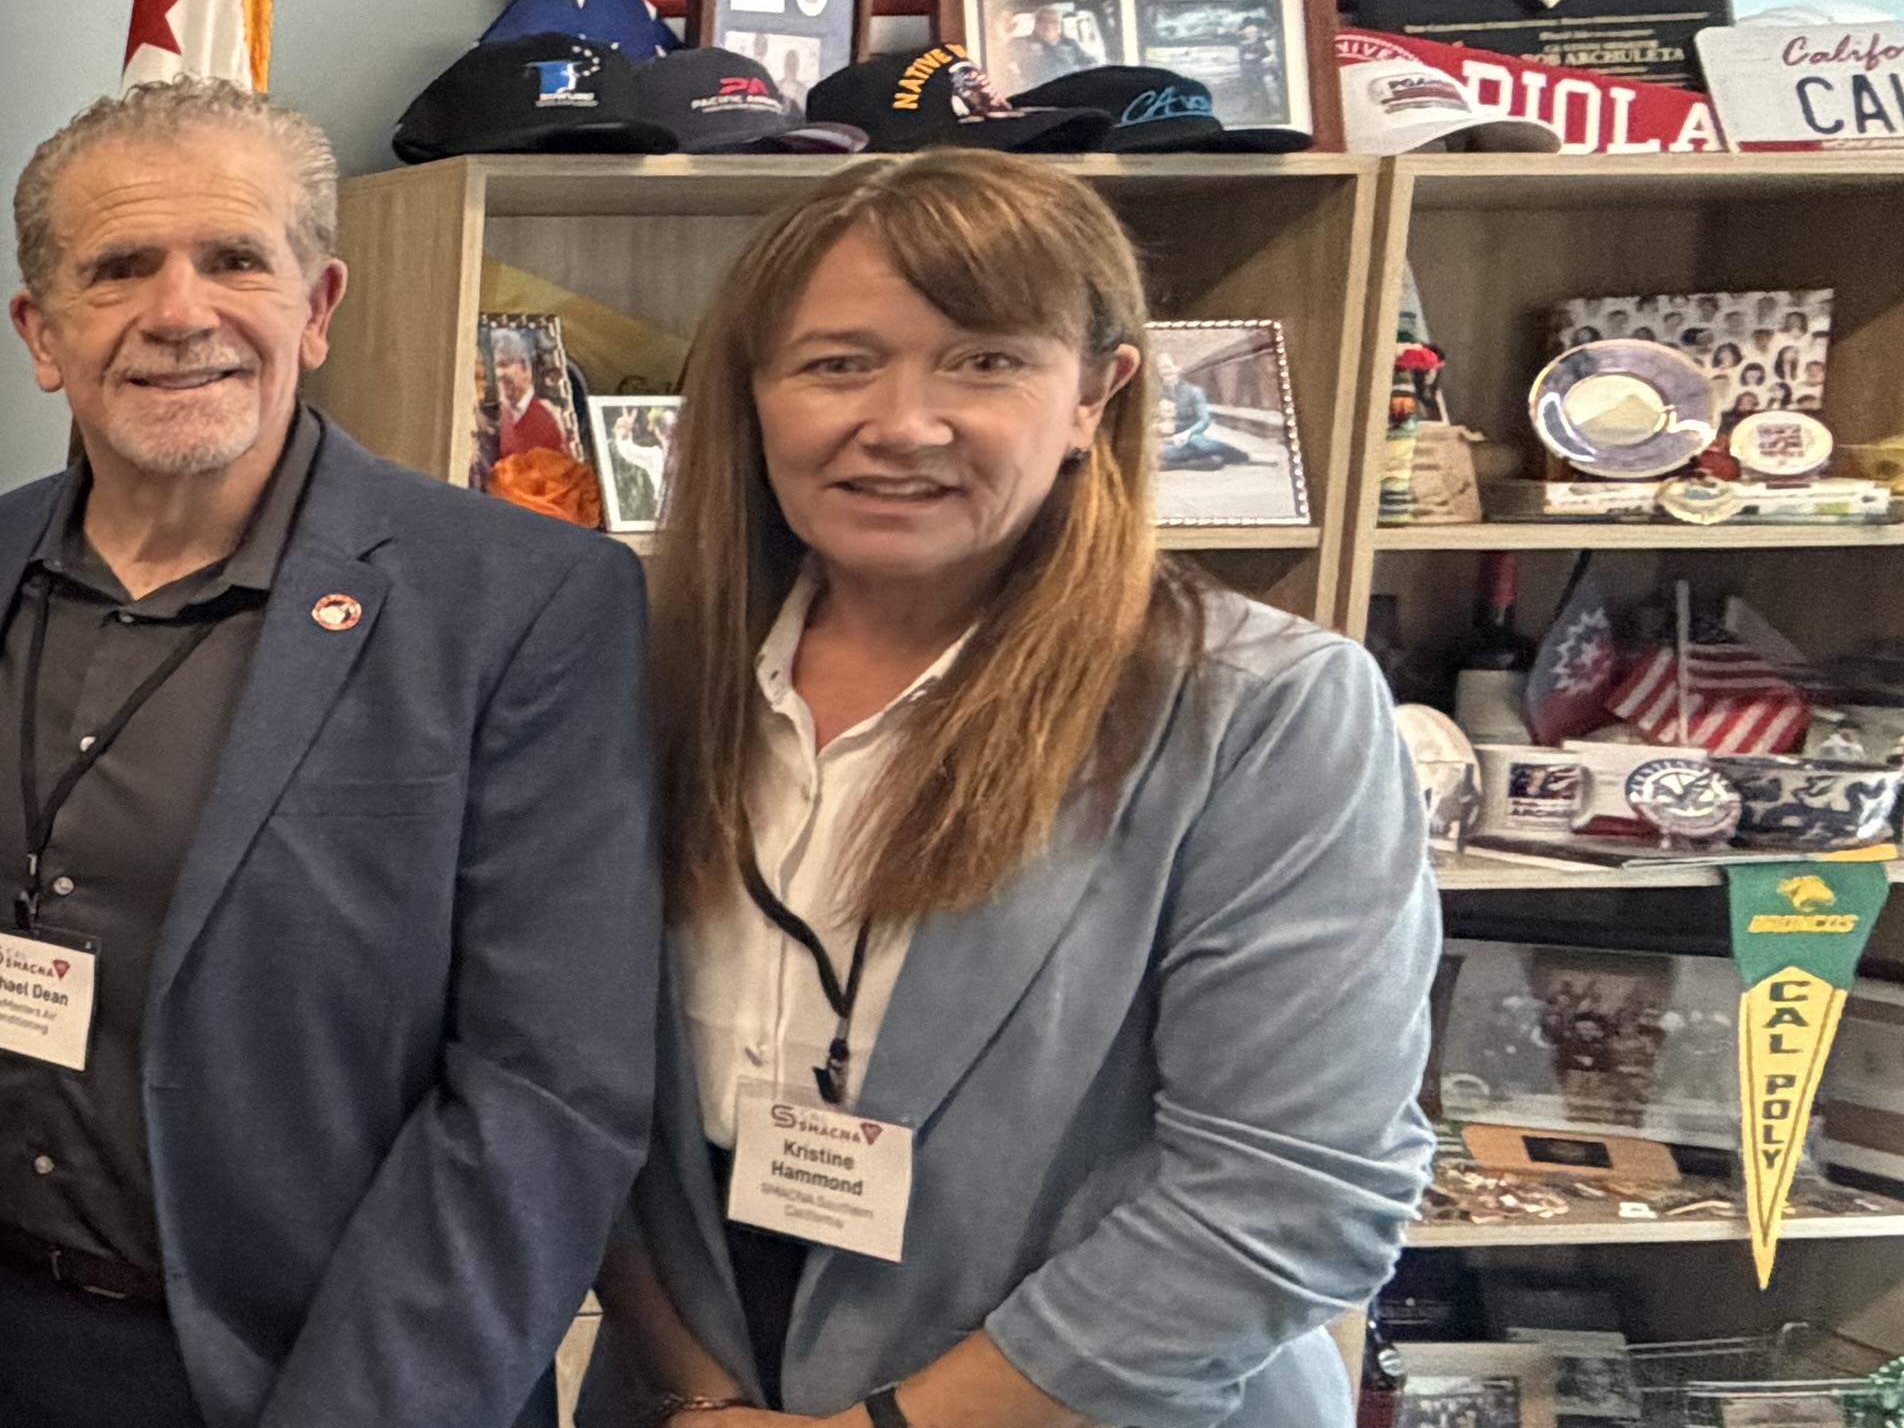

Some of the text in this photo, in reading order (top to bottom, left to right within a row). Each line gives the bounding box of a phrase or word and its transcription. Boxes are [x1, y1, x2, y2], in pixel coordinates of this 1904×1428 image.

[1566, 47, 1685, 66] ARCHULETA
[893, 47, 952, 110] NATIVE
[1795, 72, 1904, 134] CA
[5, 958, 54, 977] SMACNA
[32, 983, 69, 1006] Dean
[1761, 980, 1812, 1170] CAL POLY
[799, 1121, 861, 1143] SMACNA
[783, 1138, 855, 1170] Kristine
[771, 1159, 864, 1196] Hammond
